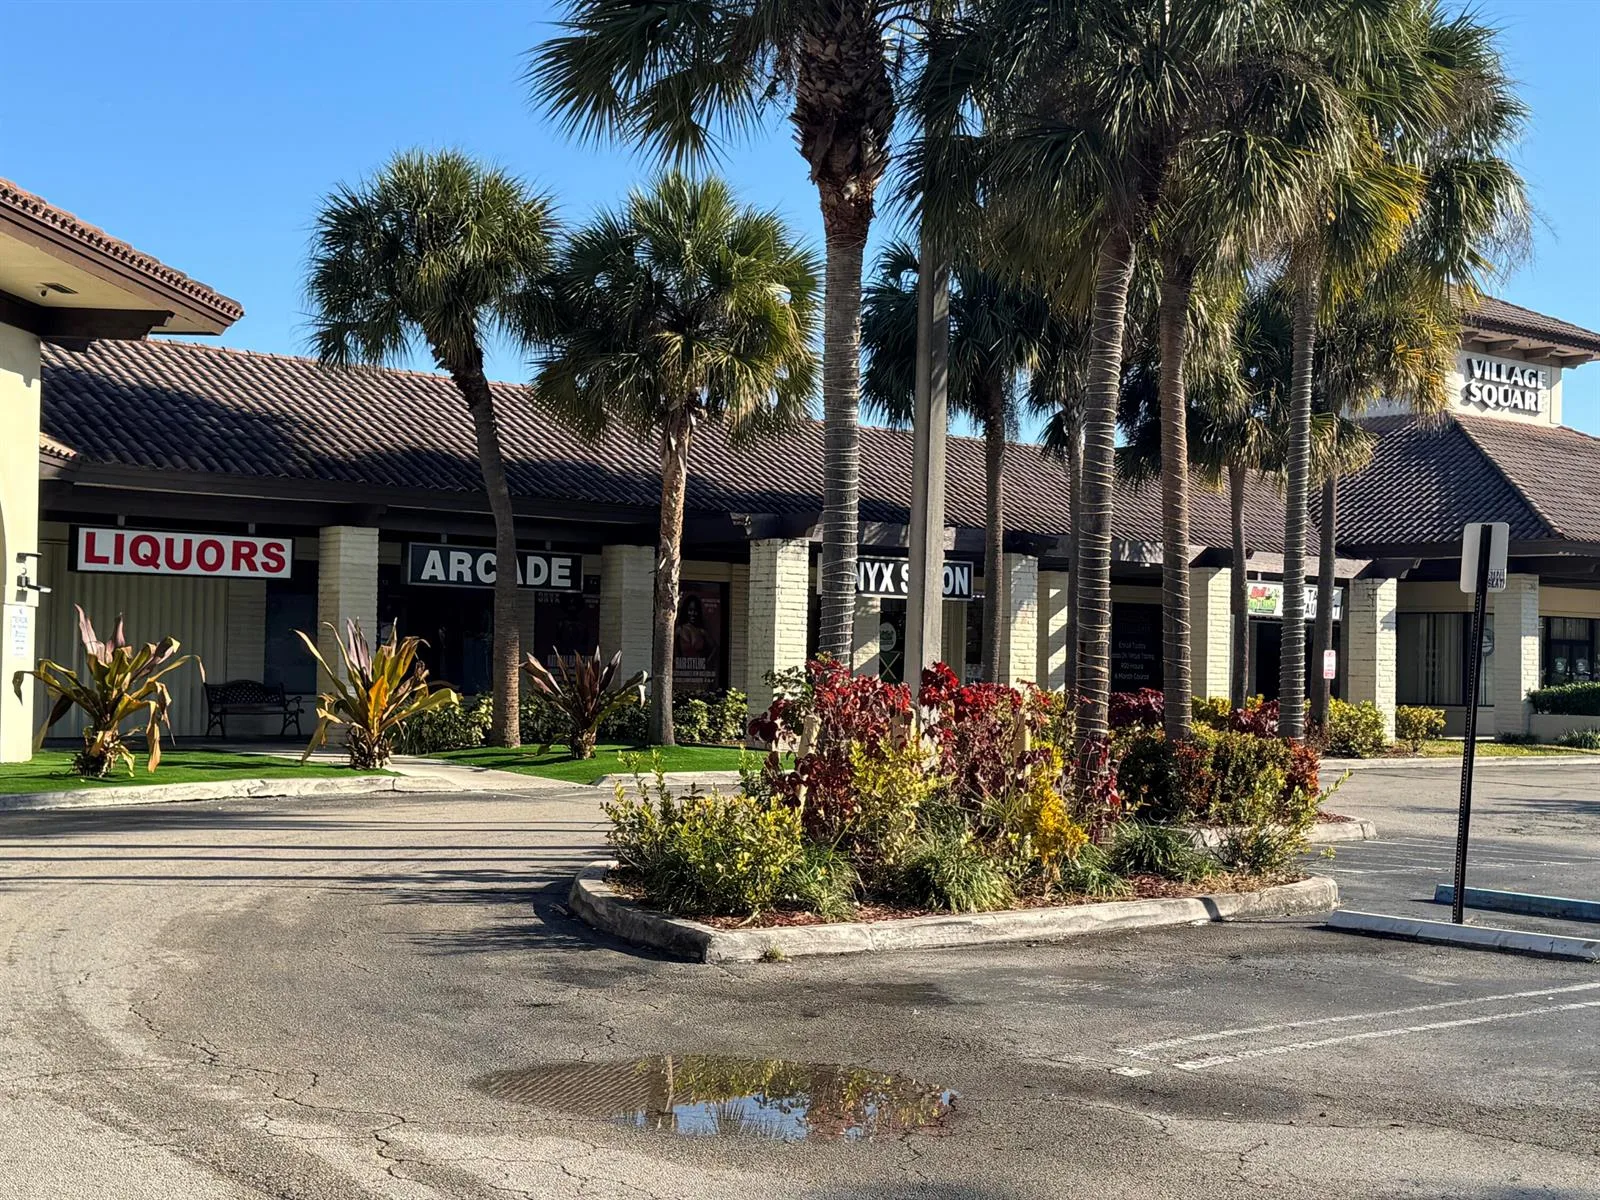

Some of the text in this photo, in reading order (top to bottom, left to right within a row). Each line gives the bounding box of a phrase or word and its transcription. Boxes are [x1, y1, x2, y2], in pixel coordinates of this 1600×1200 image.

[1471, 358, 1547, 390] VILLAGE
[84, 531, 286, 573] LIQUORS
[420, 549, 572, 587] ARCDE
[855, 561, 969, 596] NYX SON
